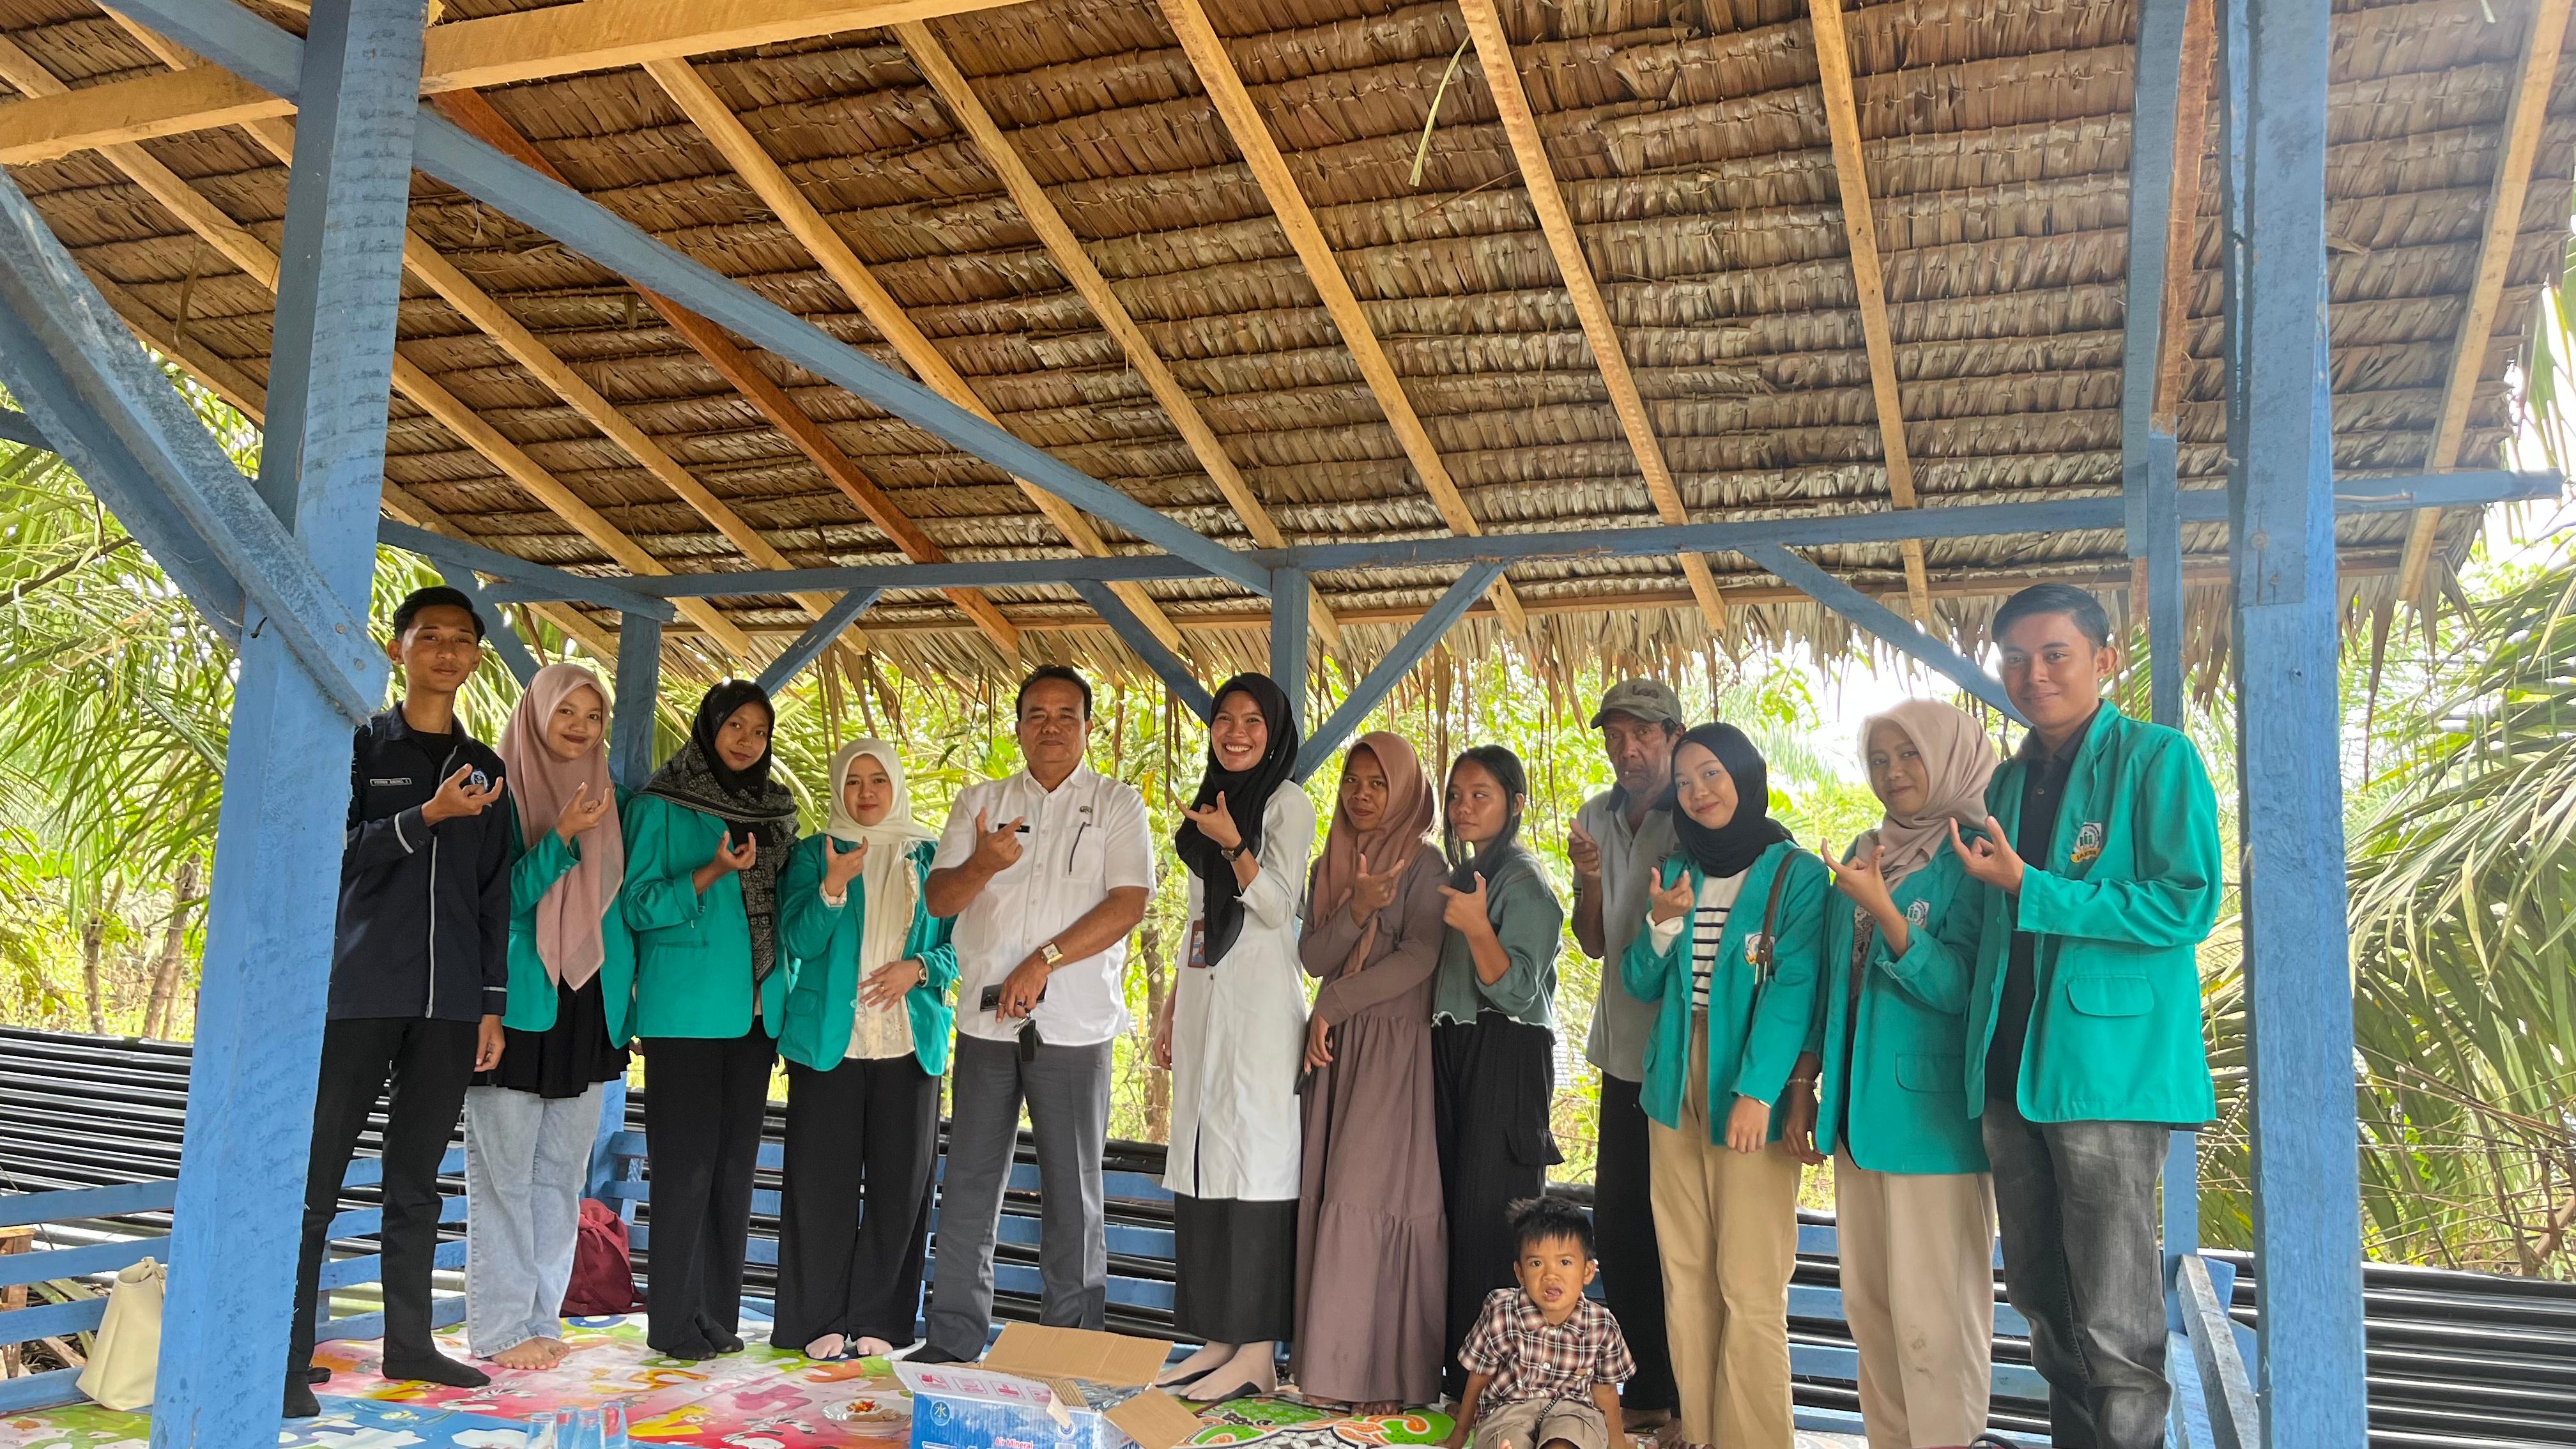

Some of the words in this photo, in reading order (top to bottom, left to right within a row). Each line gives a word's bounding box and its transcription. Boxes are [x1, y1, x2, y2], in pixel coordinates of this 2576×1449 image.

[933, 1402, 947, 1418] 水
[995, 1437, 1006, 1446] Air
[1006, 1438, 1033, 1449] Mineral
